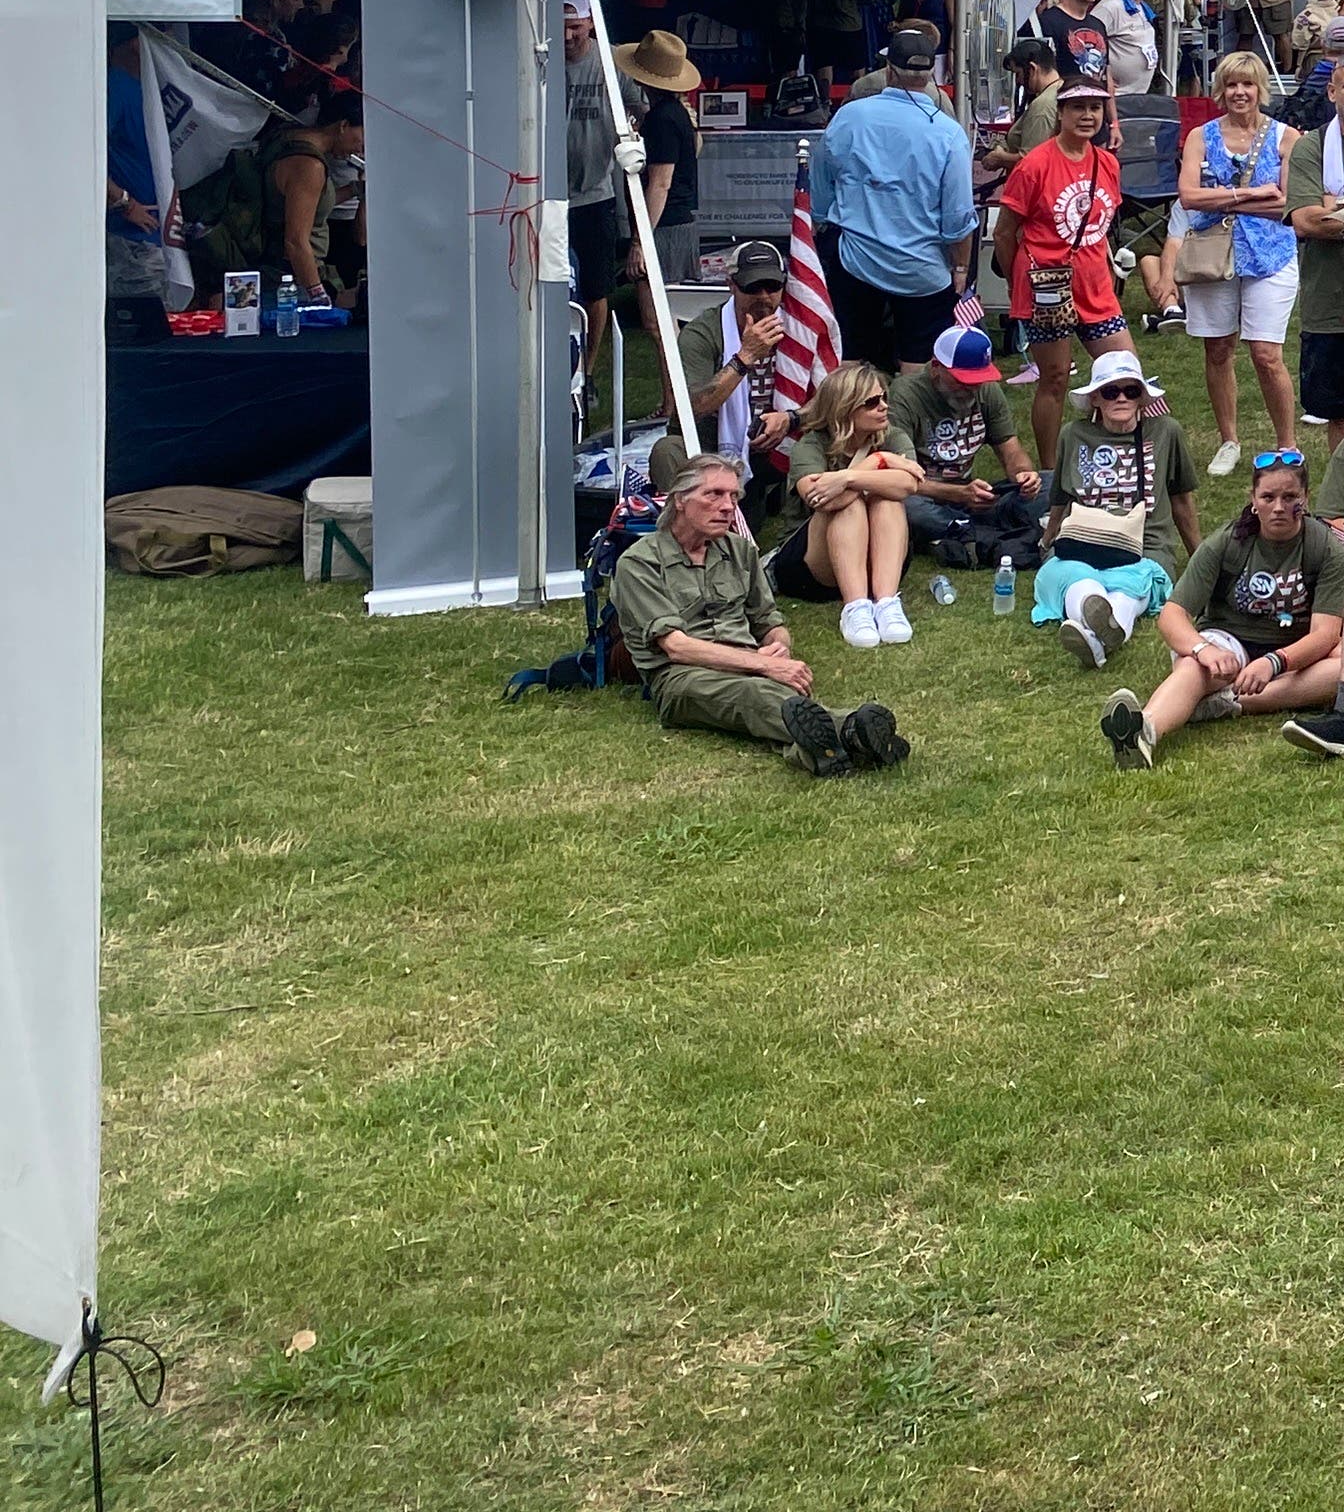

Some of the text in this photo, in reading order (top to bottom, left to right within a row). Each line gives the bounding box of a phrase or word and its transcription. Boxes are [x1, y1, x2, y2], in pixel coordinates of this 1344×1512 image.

[1053, 182, 1080, 213] CARRY
[724, 213, 767, 221] CHALLENGE
[768, 213, 783, 221] FOR
